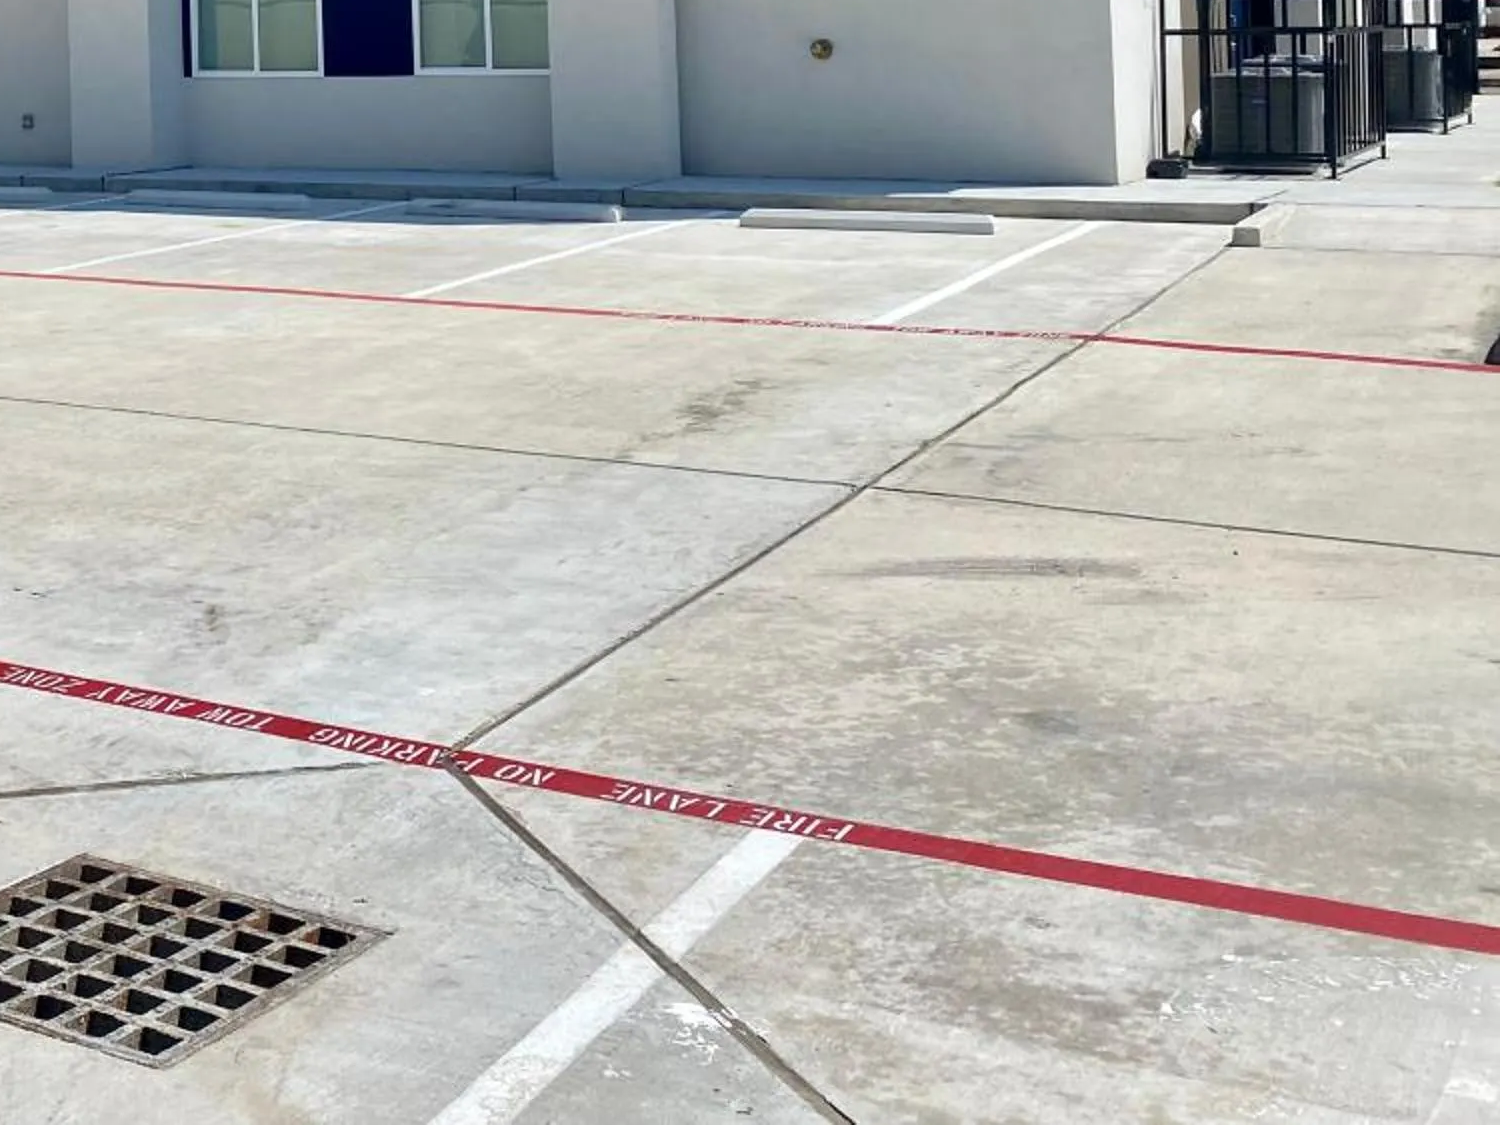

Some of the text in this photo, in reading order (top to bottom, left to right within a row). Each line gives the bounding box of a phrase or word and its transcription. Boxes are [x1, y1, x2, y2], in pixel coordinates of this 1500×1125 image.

[86, 685, 197, 714] AWAY
[194, 706, 275, 731] TOW
[493, 763, 557, 786] NO
[601, 782, 726, 819] LANE
[739, 807, 855, 841] FIRE
